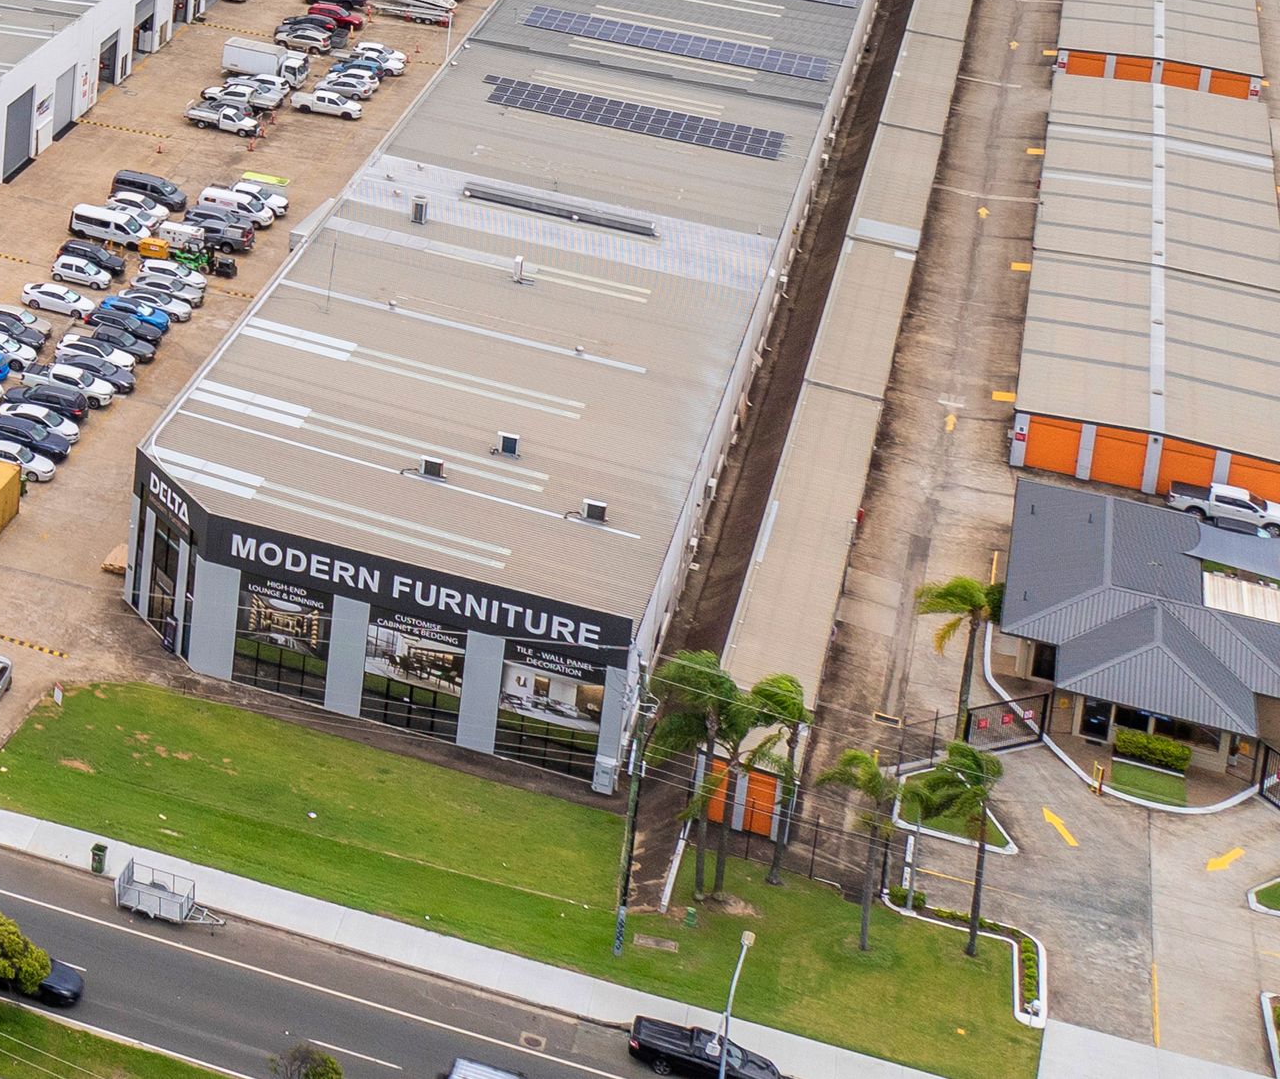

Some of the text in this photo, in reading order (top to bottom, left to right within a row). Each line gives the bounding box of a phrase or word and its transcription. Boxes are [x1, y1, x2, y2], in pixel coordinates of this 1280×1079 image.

[149, 471, 190, 526] DELTA
[230, 534, 602, 650] MODERN FURNITURE
[248, 583, 281, 598] LOUNGE
[266, 580, 307, 596] HIGH-END
[376, 618, 413, 632] CABINET
[420, 627, 459, 645] BEDDING
[394, 614, 442, 631] CUSTOMISE
[516, 645, 534, 656] TILE
[541, 651, 566, 664] WALL
[566, 658, 595, 672] PANEL
[526, 657, 582, 677] DECORATION
